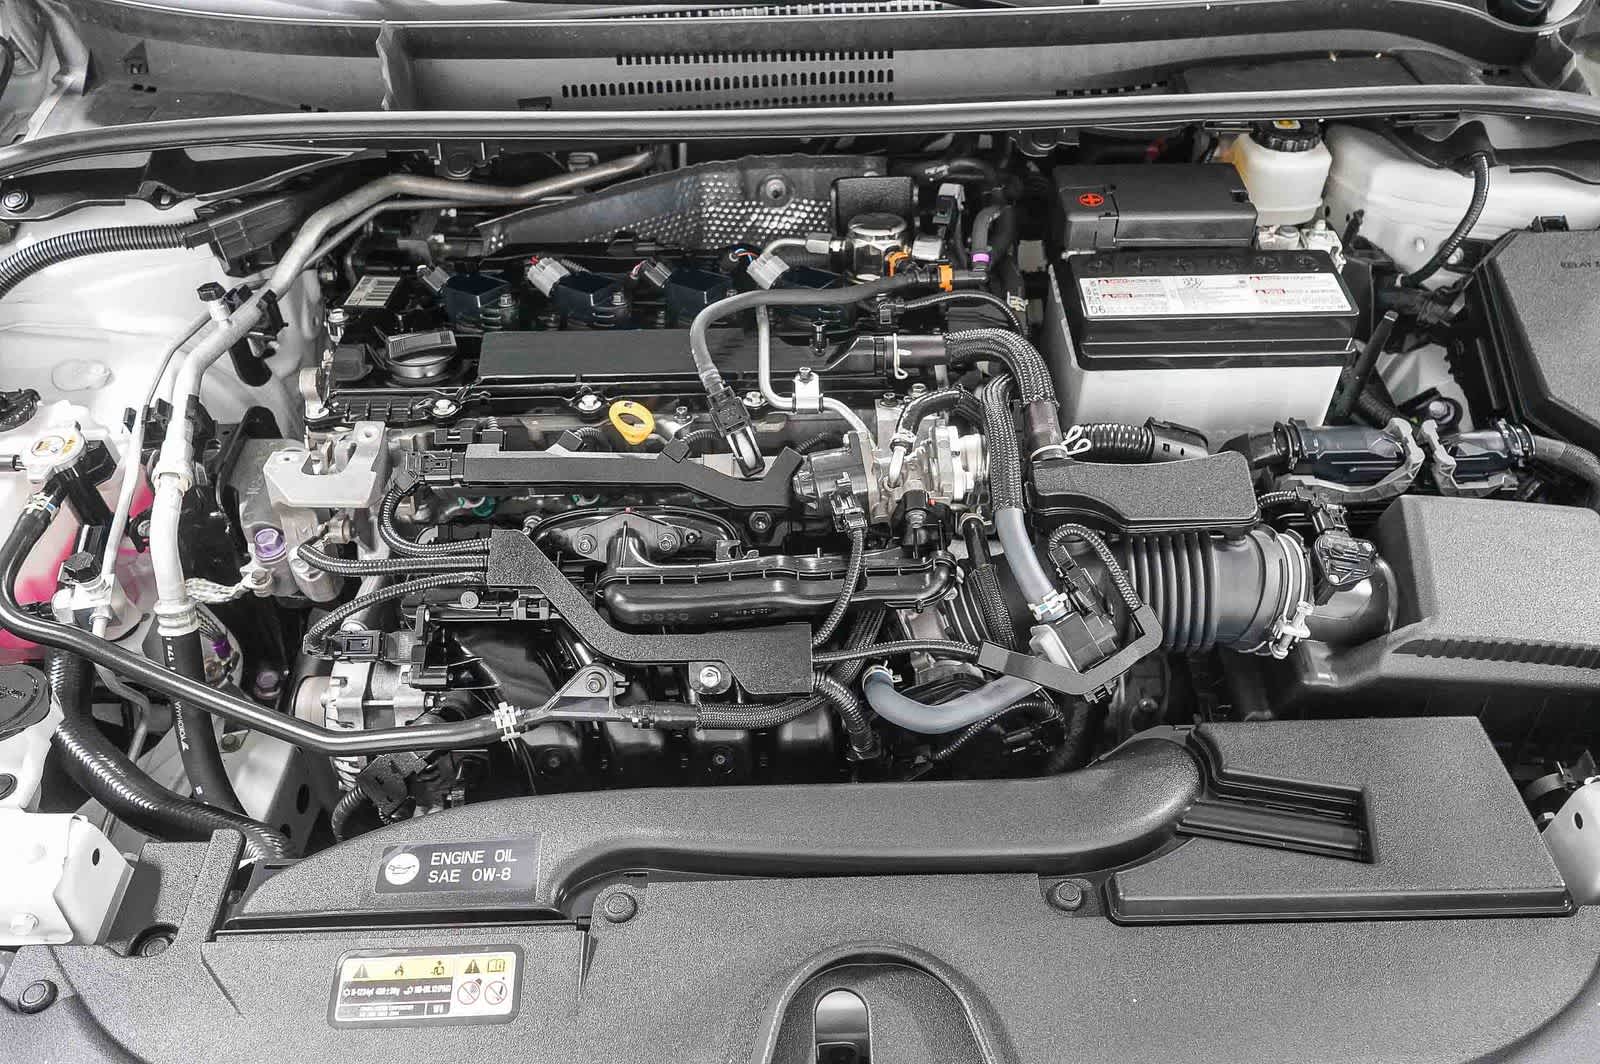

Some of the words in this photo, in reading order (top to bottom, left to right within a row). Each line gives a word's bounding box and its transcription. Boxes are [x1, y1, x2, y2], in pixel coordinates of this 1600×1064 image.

[430, 850, 485, 866] ENGINE
[494, 849, 518, 862] OIL
[427, 869, 461, 884] SAE
